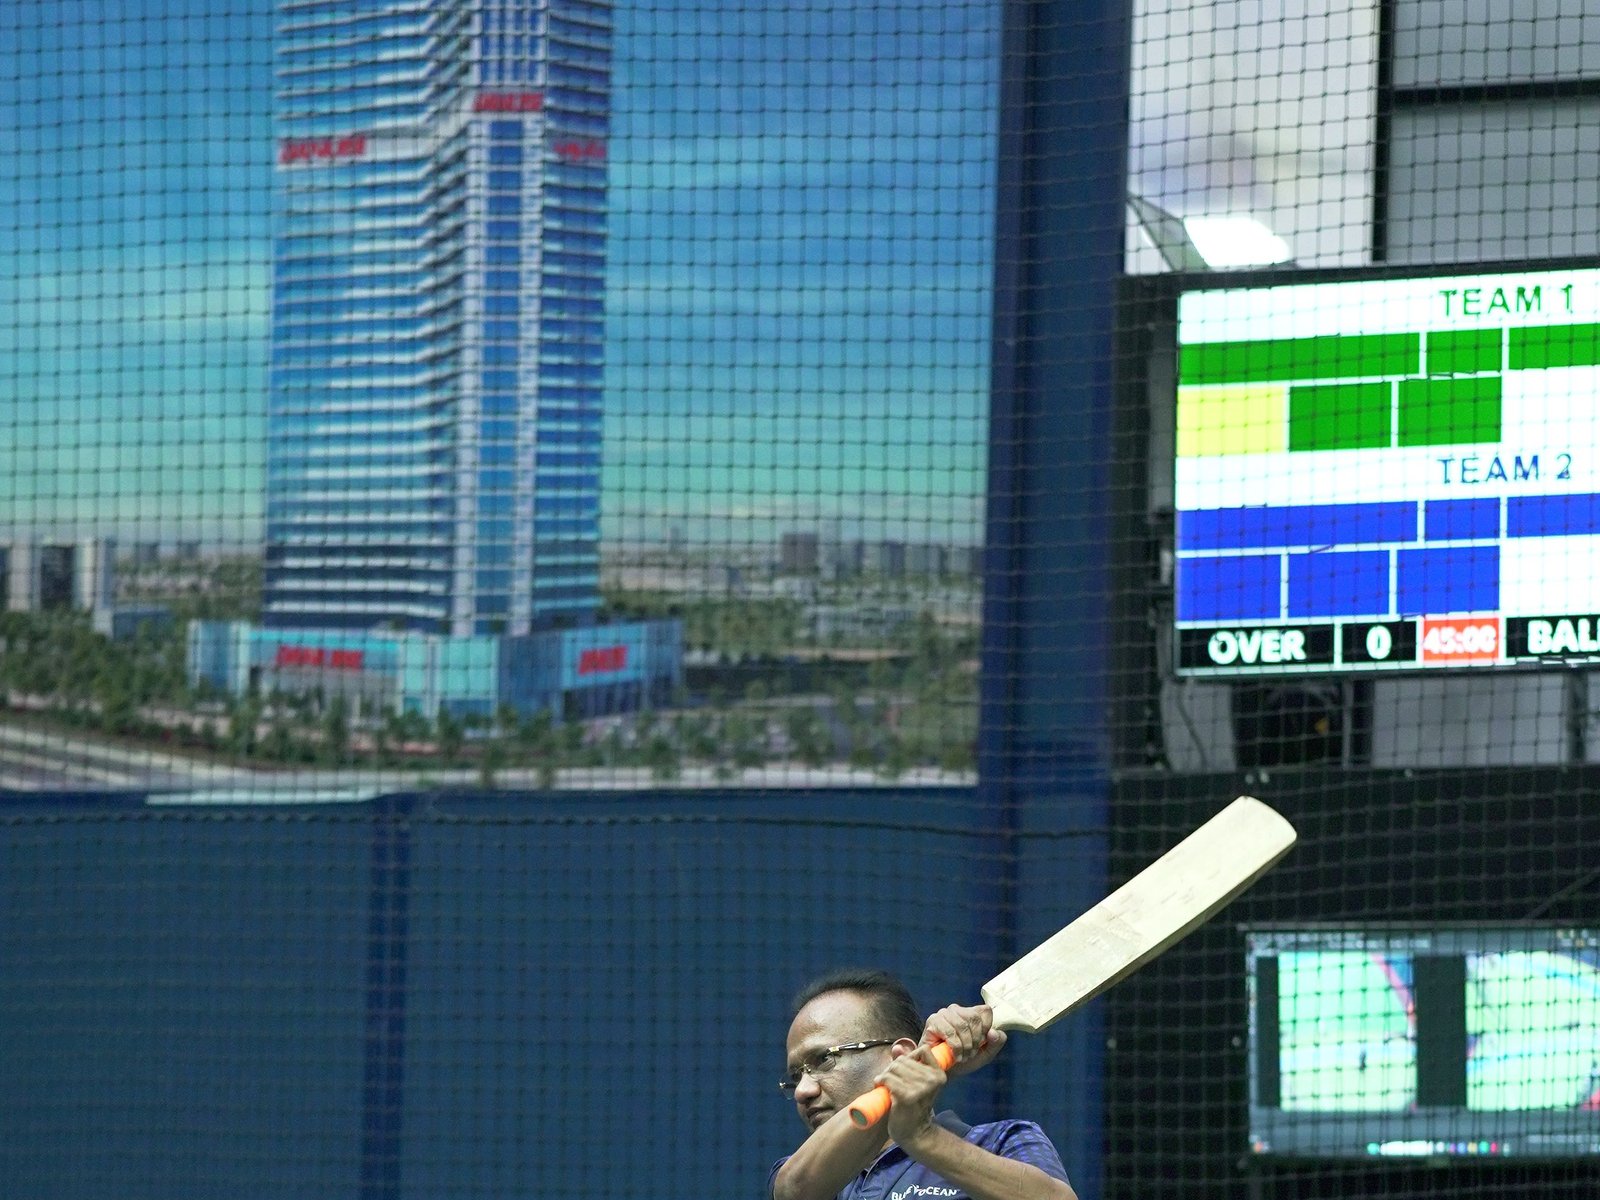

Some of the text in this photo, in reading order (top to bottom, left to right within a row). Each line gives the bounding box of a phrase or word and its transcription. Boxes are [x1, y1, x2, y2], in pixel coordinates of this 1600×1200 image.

[1439, 283, 1574, 317] TEAM 1
[1437, 453, 1572, 484] TEAM 2
[1208, 625, 1392, 665] OVER 0
[1527, 618, 1600, 654] BAL
